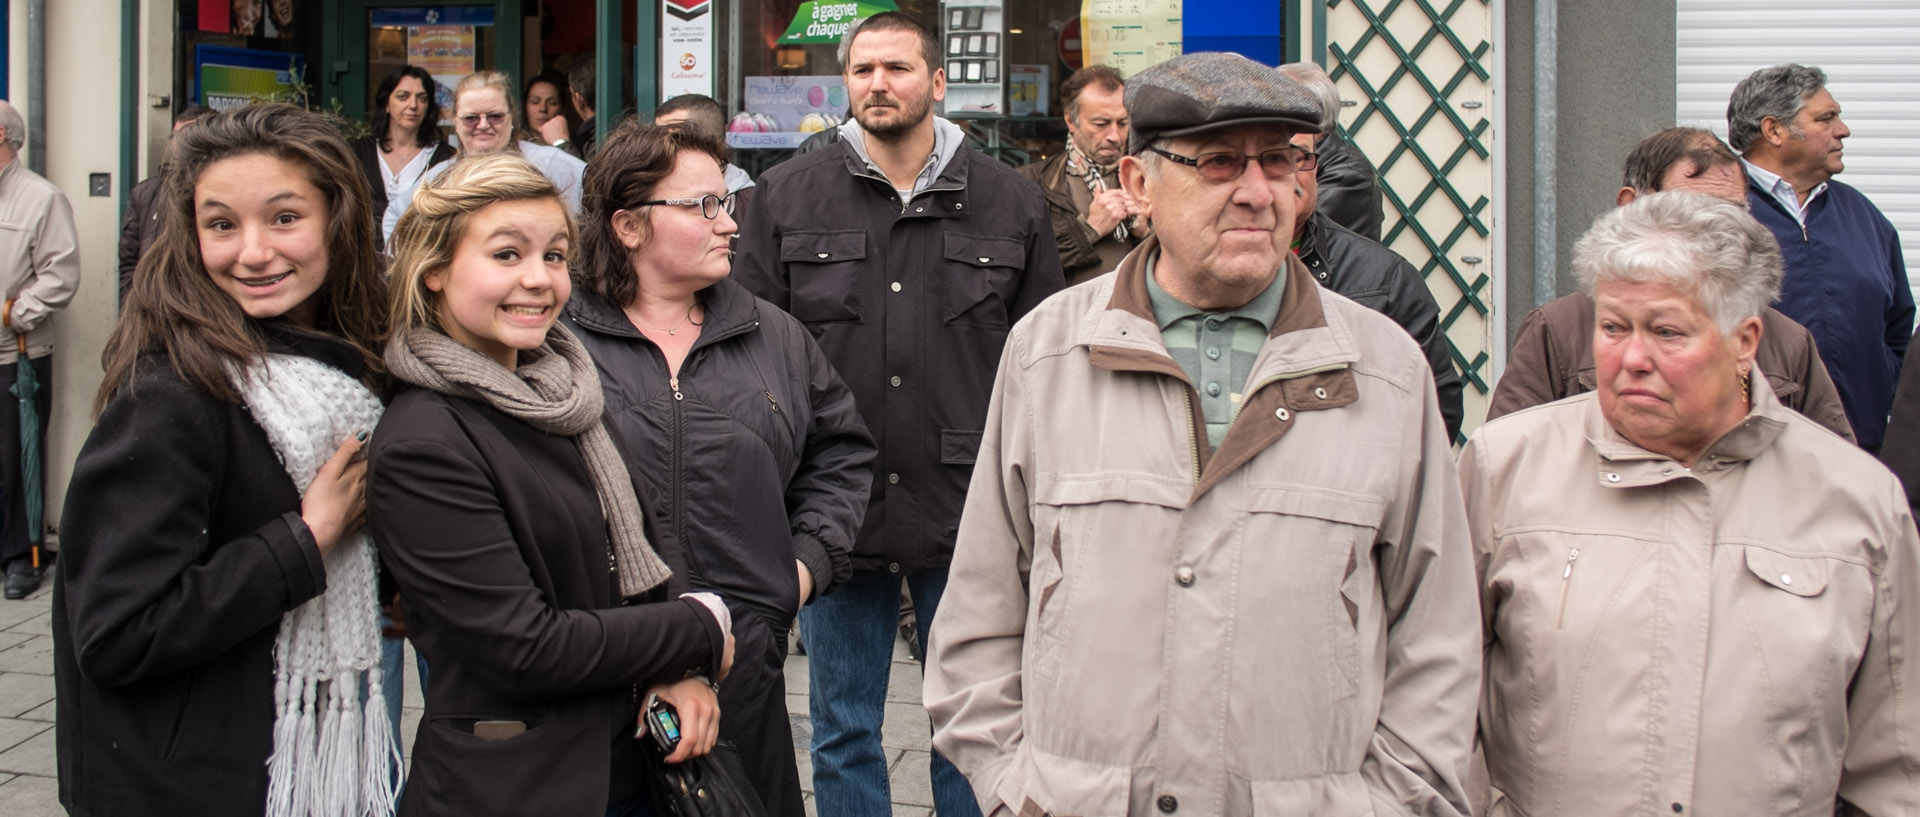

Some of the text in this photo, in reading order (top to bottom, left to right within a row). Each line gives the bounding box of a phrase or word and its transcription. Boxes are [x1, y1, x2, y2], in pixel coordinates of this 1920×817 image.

[812, 2, 858, 22] à gagner
[807, 21, 848, 39] chaque
[680, 56, 695, 67] SO
[671, 72, 703, 80] Colissimo
[734, 133, 787, 145] newave
